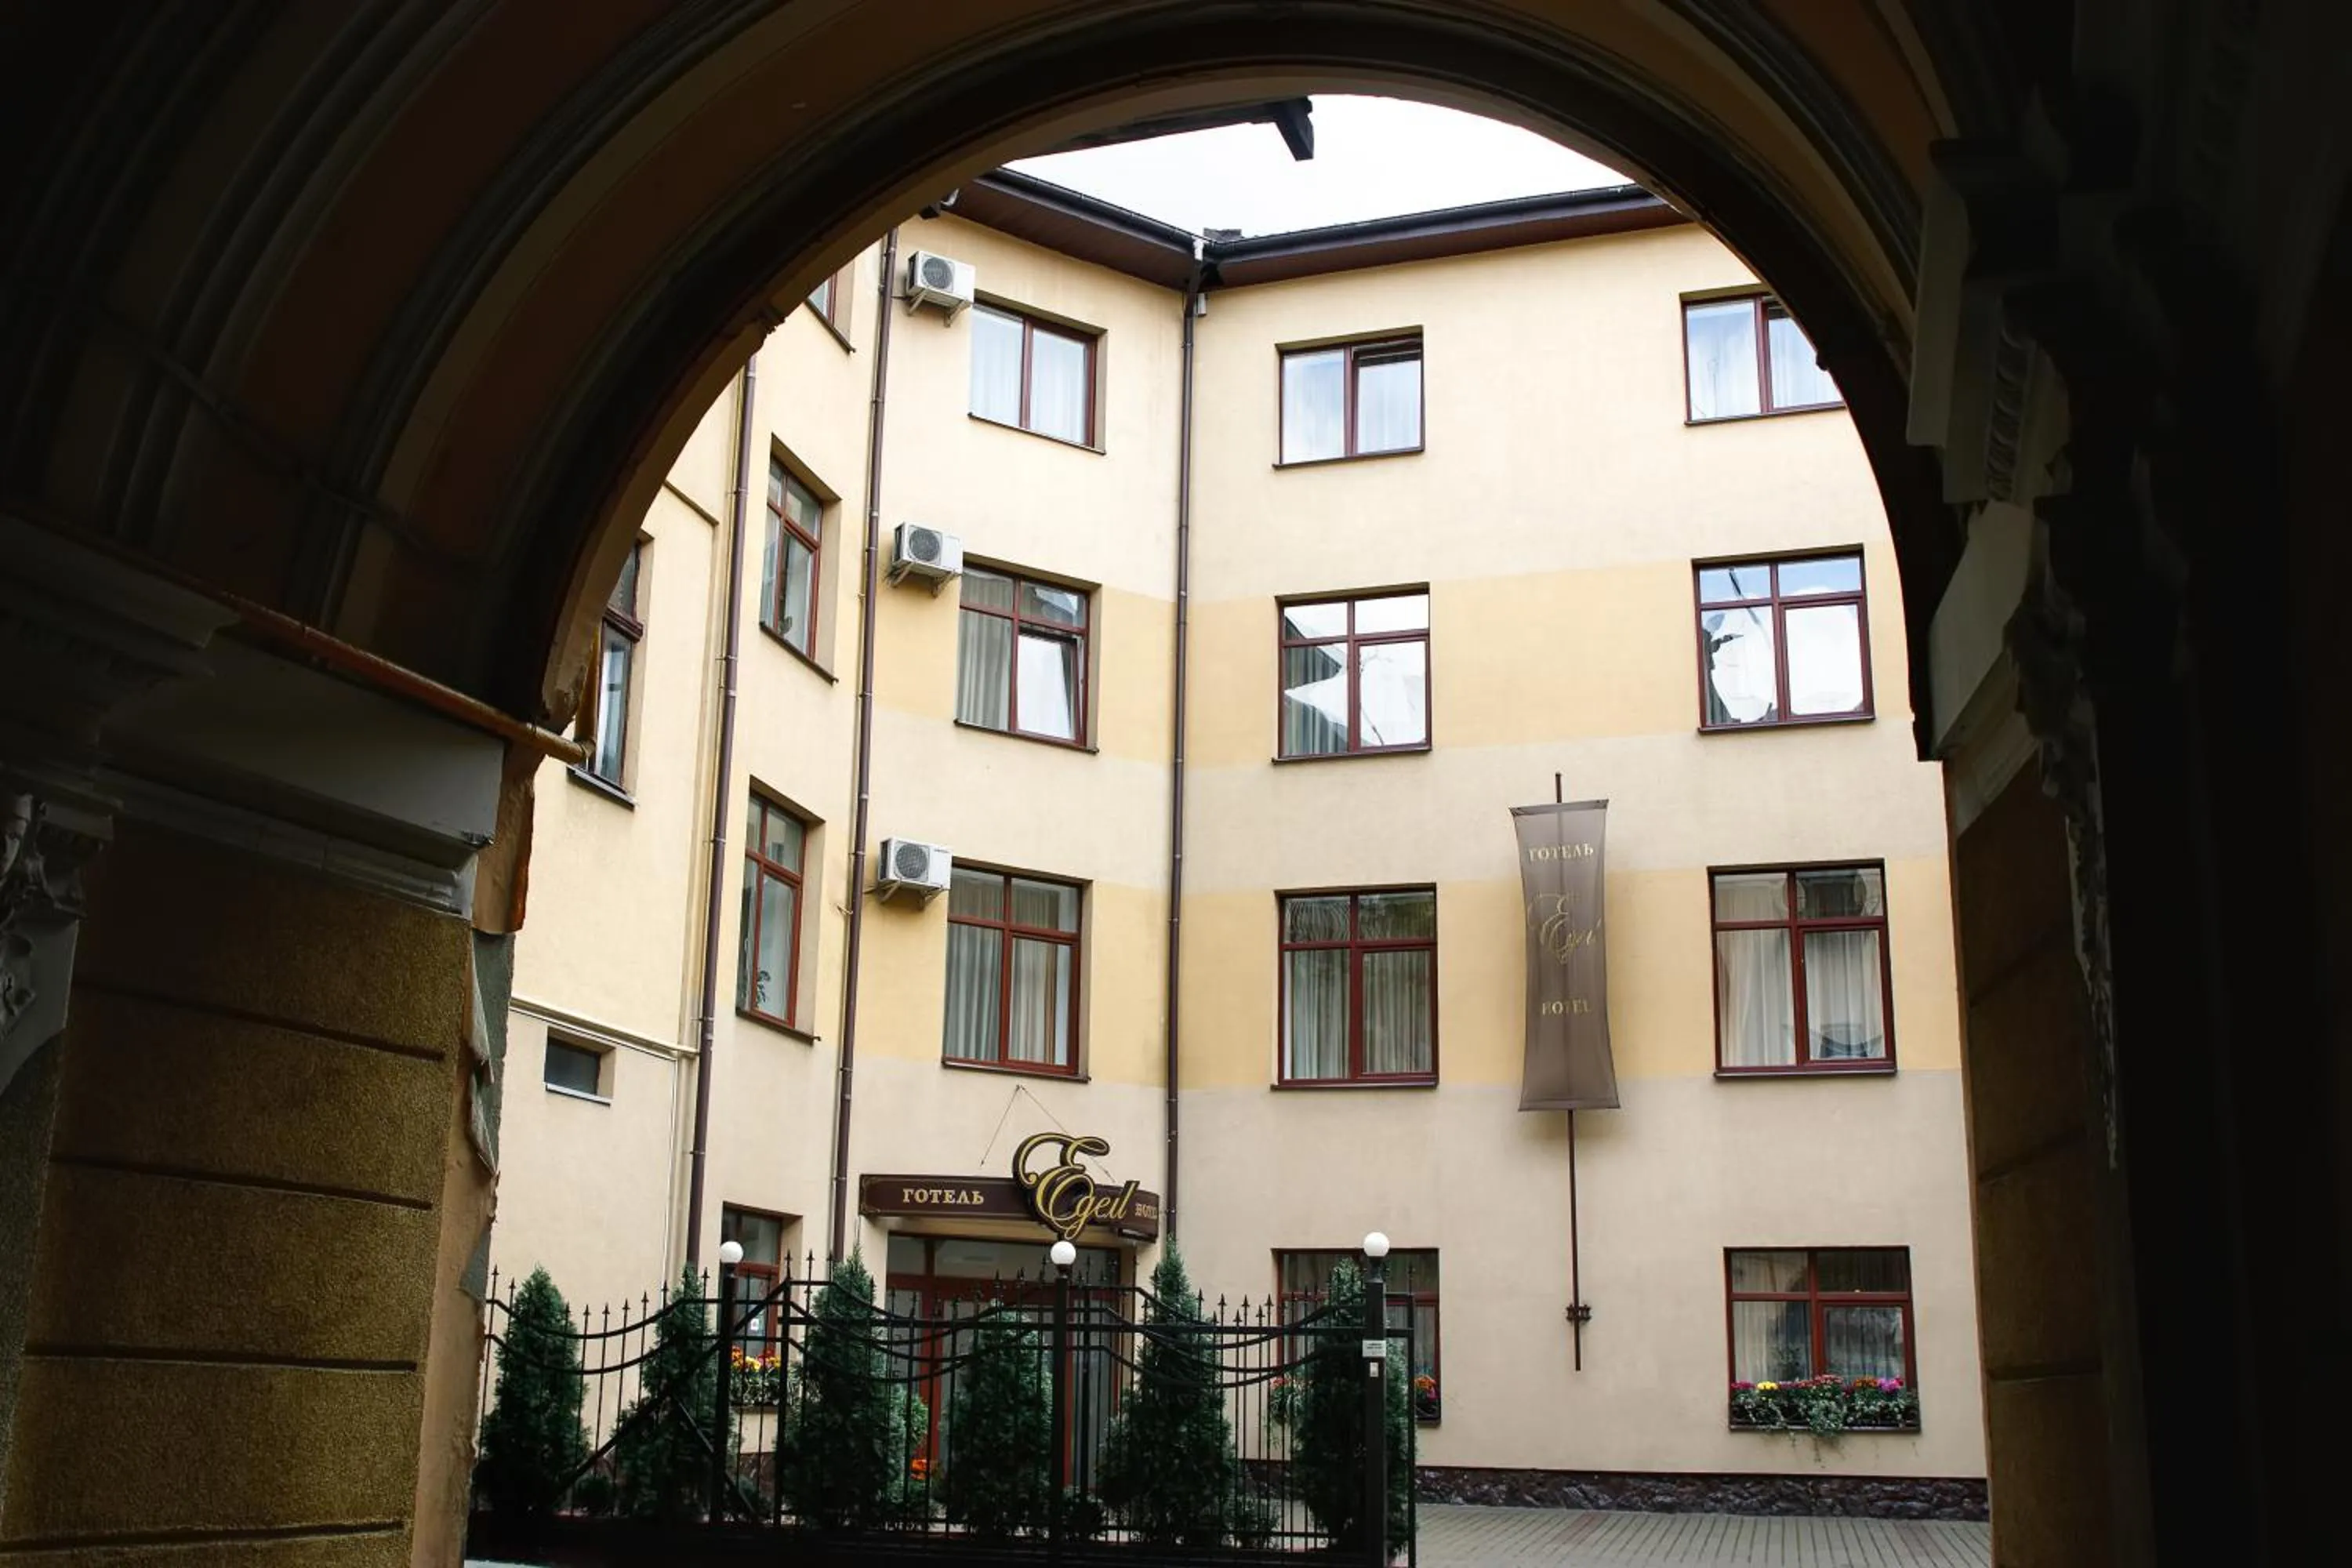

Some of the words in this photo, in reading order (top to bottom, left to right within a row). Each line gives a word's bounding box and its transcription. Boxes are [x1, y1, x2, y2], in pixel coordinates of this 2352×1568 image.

[1528, 843, 1594, 862] ГОТЕЛЬ
[902, 1188, 985, 1205] ГОТЕЛЬ
[1134, 1202, 1158, 1220] HOTE
